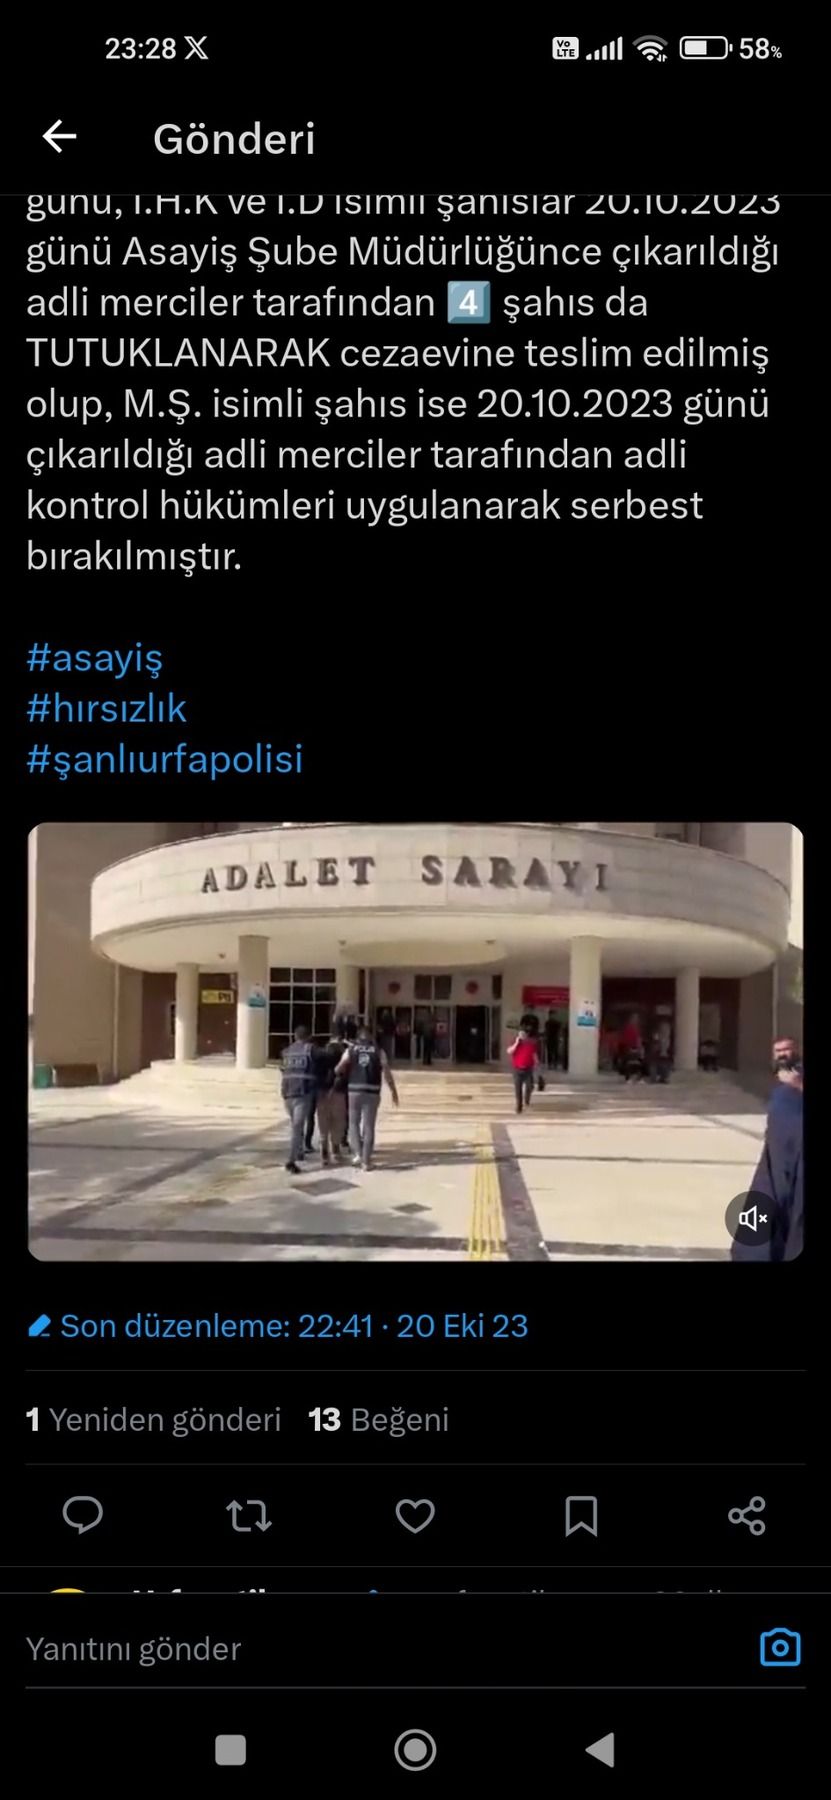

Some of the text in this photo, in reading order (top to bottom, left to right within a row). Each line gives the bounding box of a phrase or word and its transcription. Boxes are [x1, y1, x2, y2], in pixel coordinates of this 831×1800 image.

[106, 38, 176, 59] 23:28
[556, 40, 571, 48] Vo
[556, 48, 576, 57] LTE
[740, 38, 782, 59] 58%
[154, 121, 314, 154] Gönderi
[228, 195, 266, 214] ve
[586, 195, 780, 214] 20.10.2023
[26, 235, 777, 273] günü Asayiş Şube Müdürlüğünce çıkarıldığı
[27, 286, 88, 316] adli
[101, 286, 244, 316] merciler
[253, 286, 434, 316] tarafından
[504, 286, 594, 323] şahıs
[606, 286, 647, 316] da
[26, 337, 768, 374] TUTUKLANARAK cezaevine teslim edilmiş
[27, 387, 768, 425] olup, M.Ş. isimli şahıs ise 20.10.2023 günü
[27, 438, 686, 476] çıkarıldığı adli merciler tarafından adli
[28, 489, 703, 527] kontrol hükümleri uygulanarak serbest
[28, 540, 240, 577] bırakılmıştır.
[27, 642, 162, 679] #asayiş
[27, 692, 186, 722] #hırsızlık
[27, 743, 302, 780] #şanlıurfapolisi
[201, 855, 608, 893] ADALET SARAYI
[61, 1313, 528, 1337] Son düzenleme: 22:41 20 Eki 23
[26, 1407, 448, 1437] 1 Yeniden gönderi 13 Beğeni
[26, 1636, 241, 1666] Yanıtını gönder
